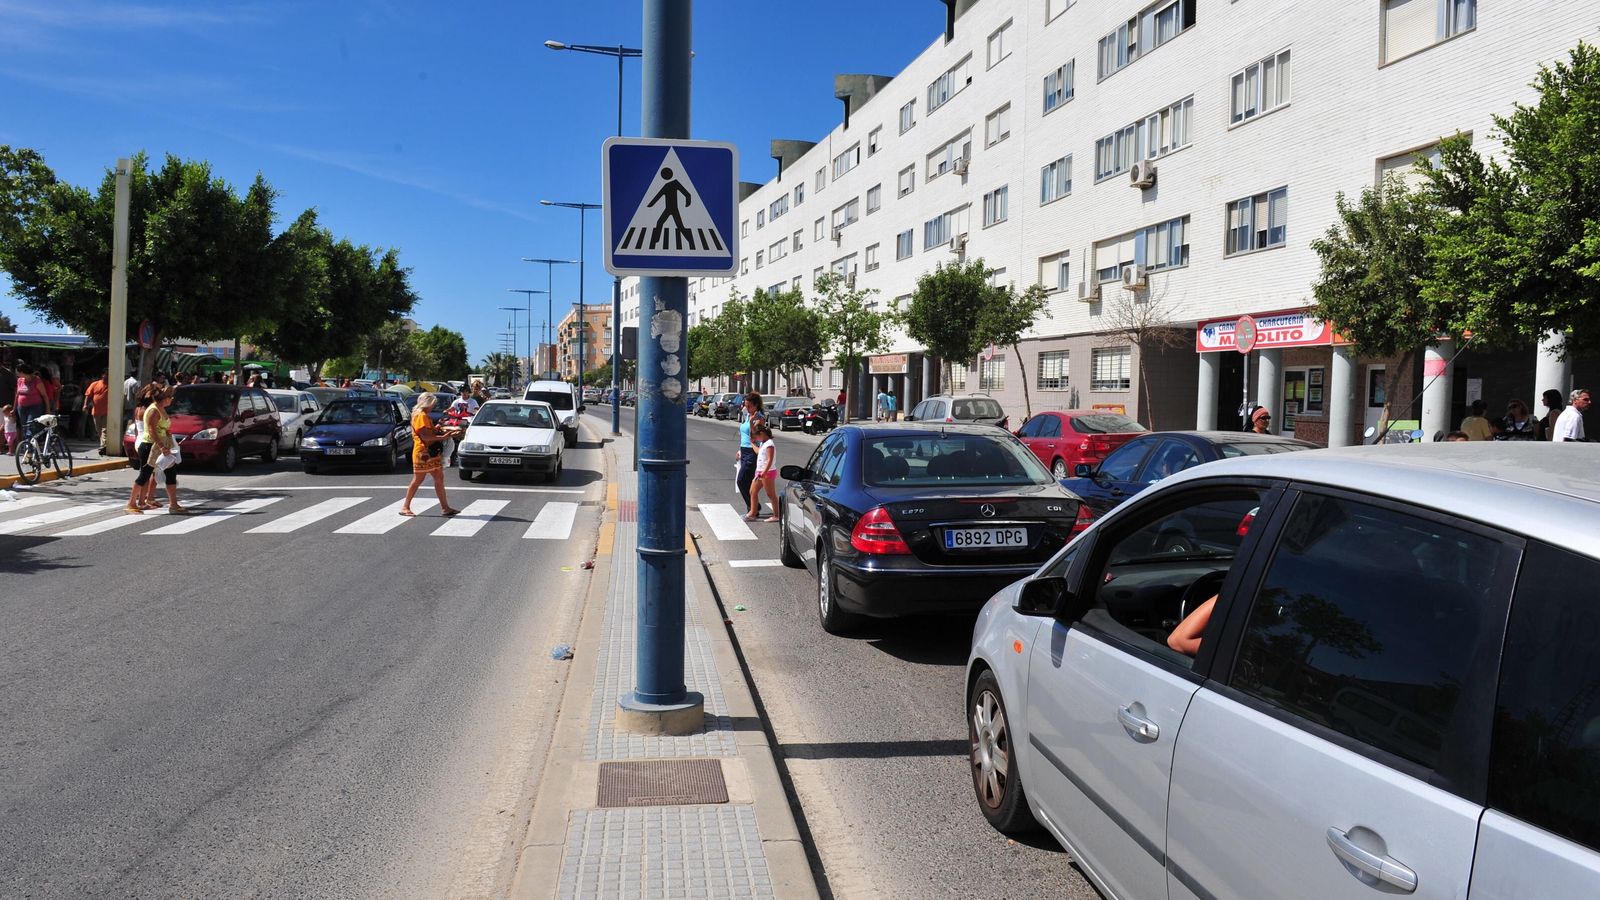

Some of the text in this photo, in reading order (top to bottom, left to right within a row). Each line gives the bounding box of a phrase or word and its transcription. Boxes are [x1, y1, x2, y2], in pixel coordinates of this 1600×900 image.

[1218, 329, 1303, 346] MOLITO
[955, 530, 1022, 546] 6892 DPG
